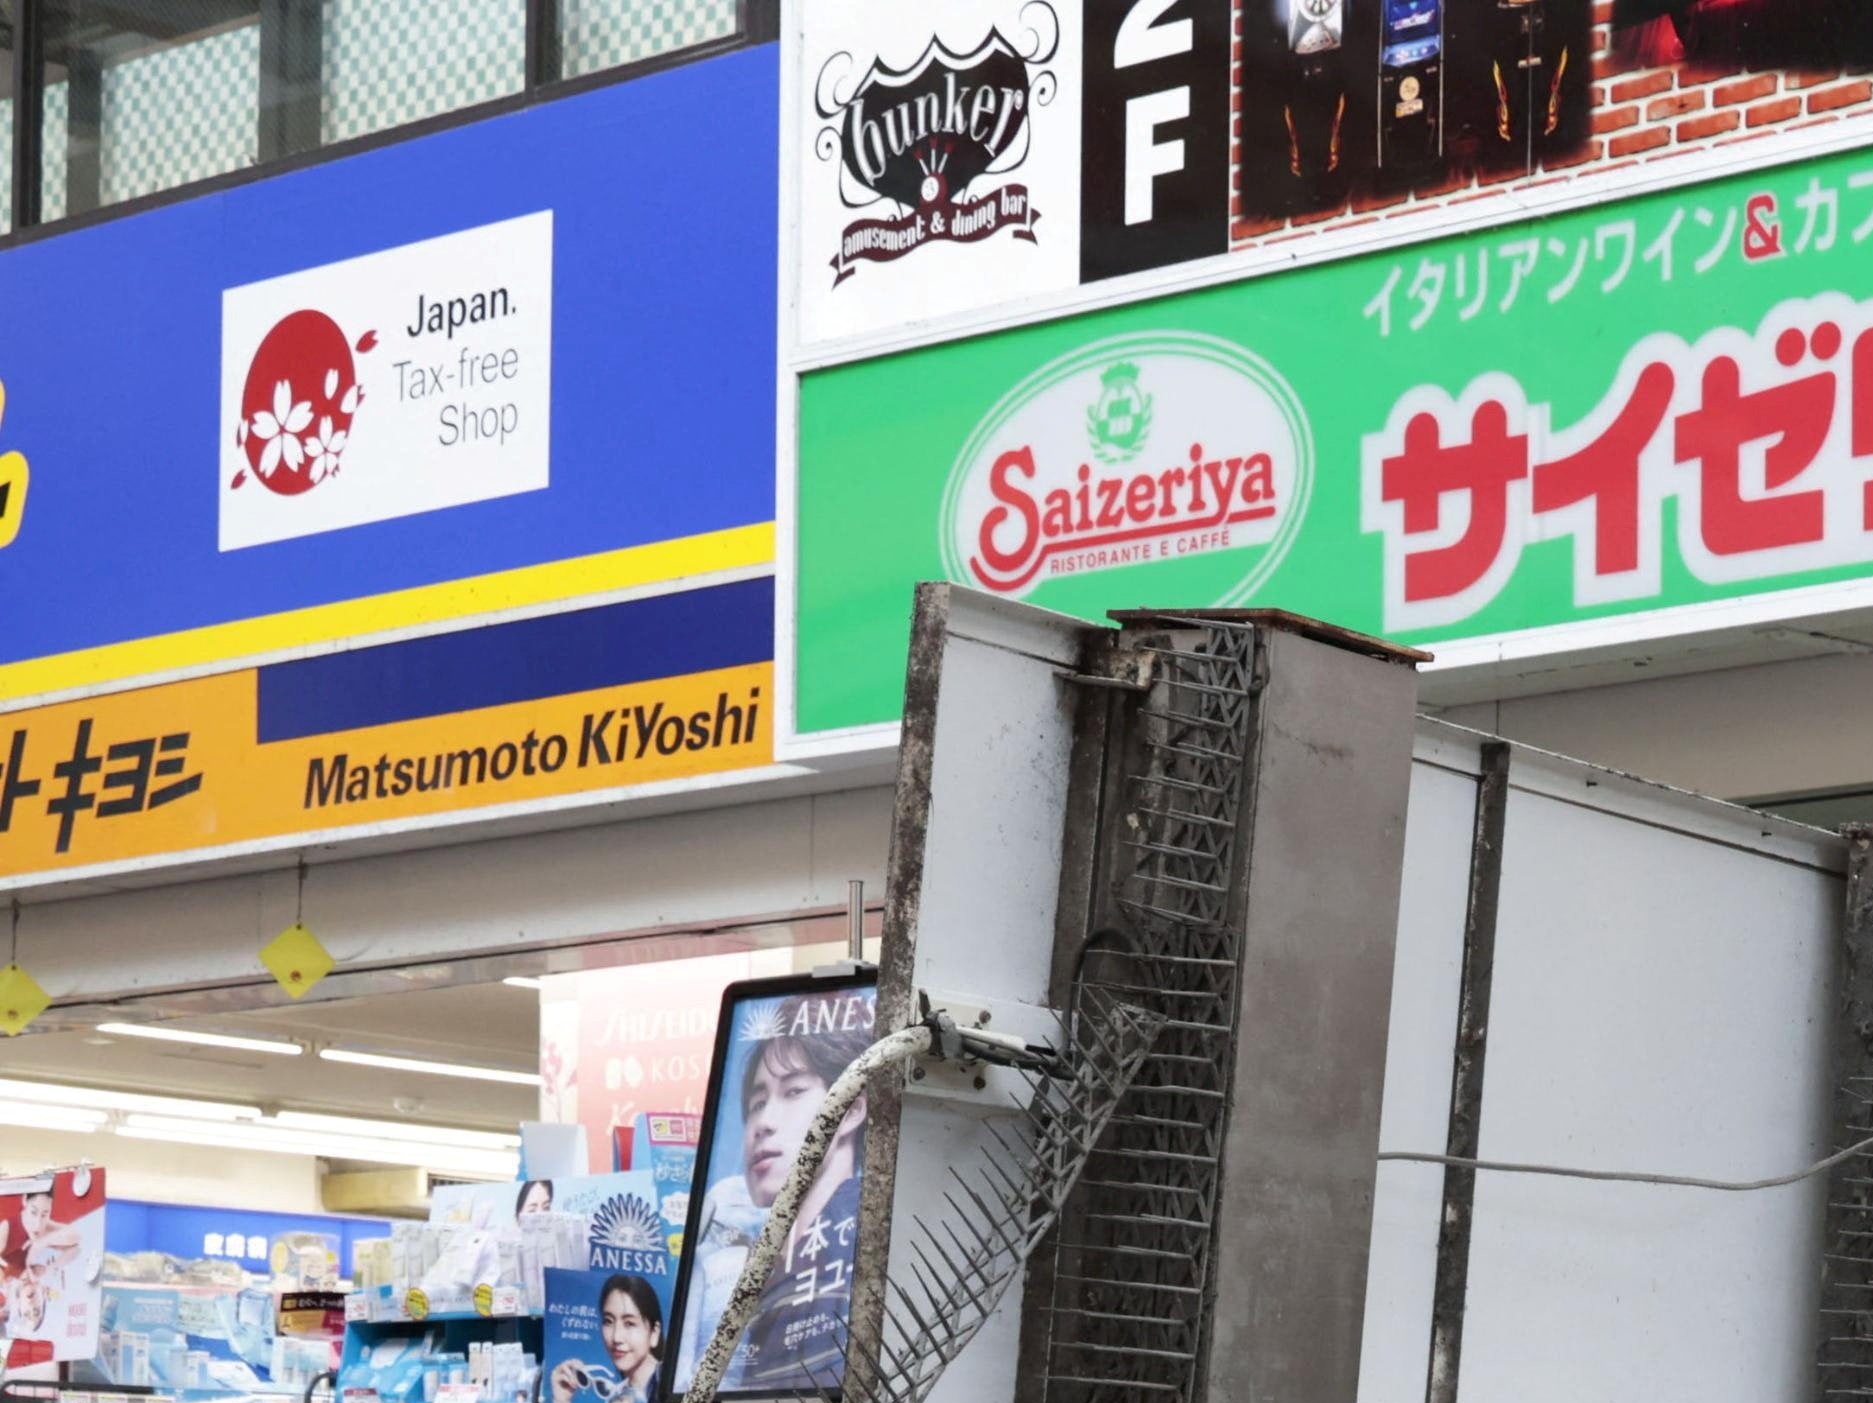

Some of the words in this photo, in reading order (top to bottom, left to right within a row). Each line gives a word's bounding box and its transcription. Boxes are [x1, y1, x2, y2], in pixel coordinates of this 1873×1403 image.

[849, 73, 1024, 187] bunker
[843, 213, 926, 257] amusement
[929, 201, 946, 233] &
[951, 200, 996, 237] dining
[1000, 186, 1026, 217] bar
[406, 285, 518, 340] Japan.
[393, 345, 519, 403] Tax-free
[439, 401, 518, 447] Shop
[970, 443, 1277, 592] Saizeriya
[1051, 541, 1152, 574] RISTORANTE
[1160, 539, 1169, 556] E
[303, 735, 567, 809] Matsumoto
[577, 687, 761, 769] KiYoshi
[0, 717, 204, 854] トキヨシ
[652, 1055, 713, 1084] KOS
[590, 1247, 668, 1276] ANESSA
